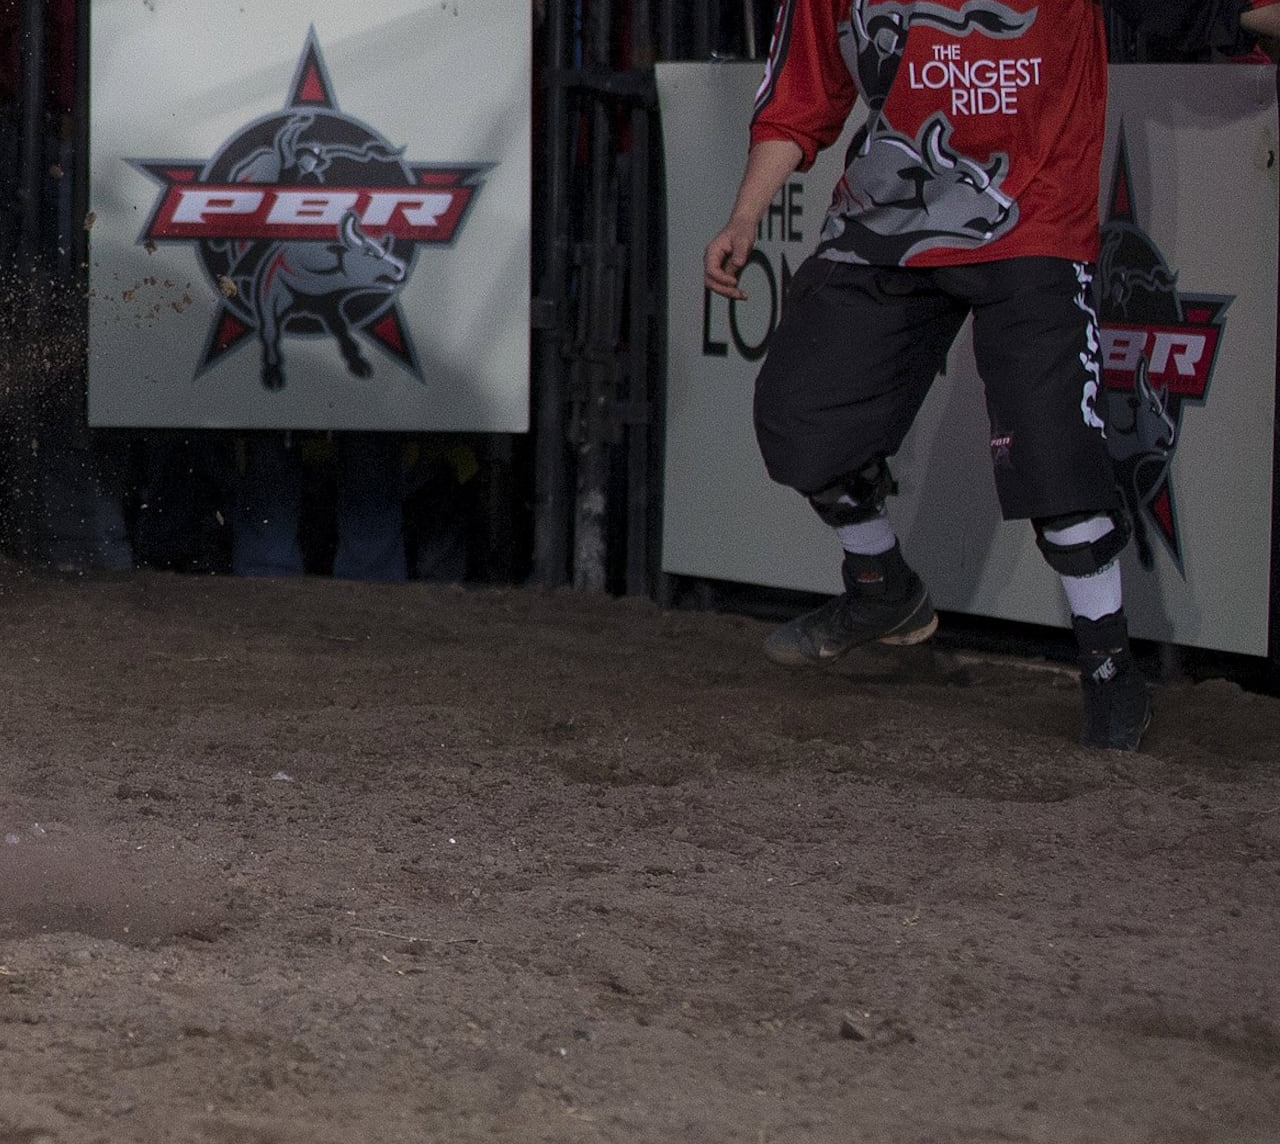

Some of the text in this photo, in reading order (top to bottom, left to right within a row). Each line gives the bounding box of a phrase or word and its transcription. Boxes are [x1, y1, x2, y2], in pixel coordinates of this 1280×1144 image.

[931, 44, 961, 61] THE
[908, 57, 1042, 89] LONGEST
[951, 87, 1018, 116] RIDE
[170, 189, 454, 227] PBR
[1099, 328, 1207, 376] BR
